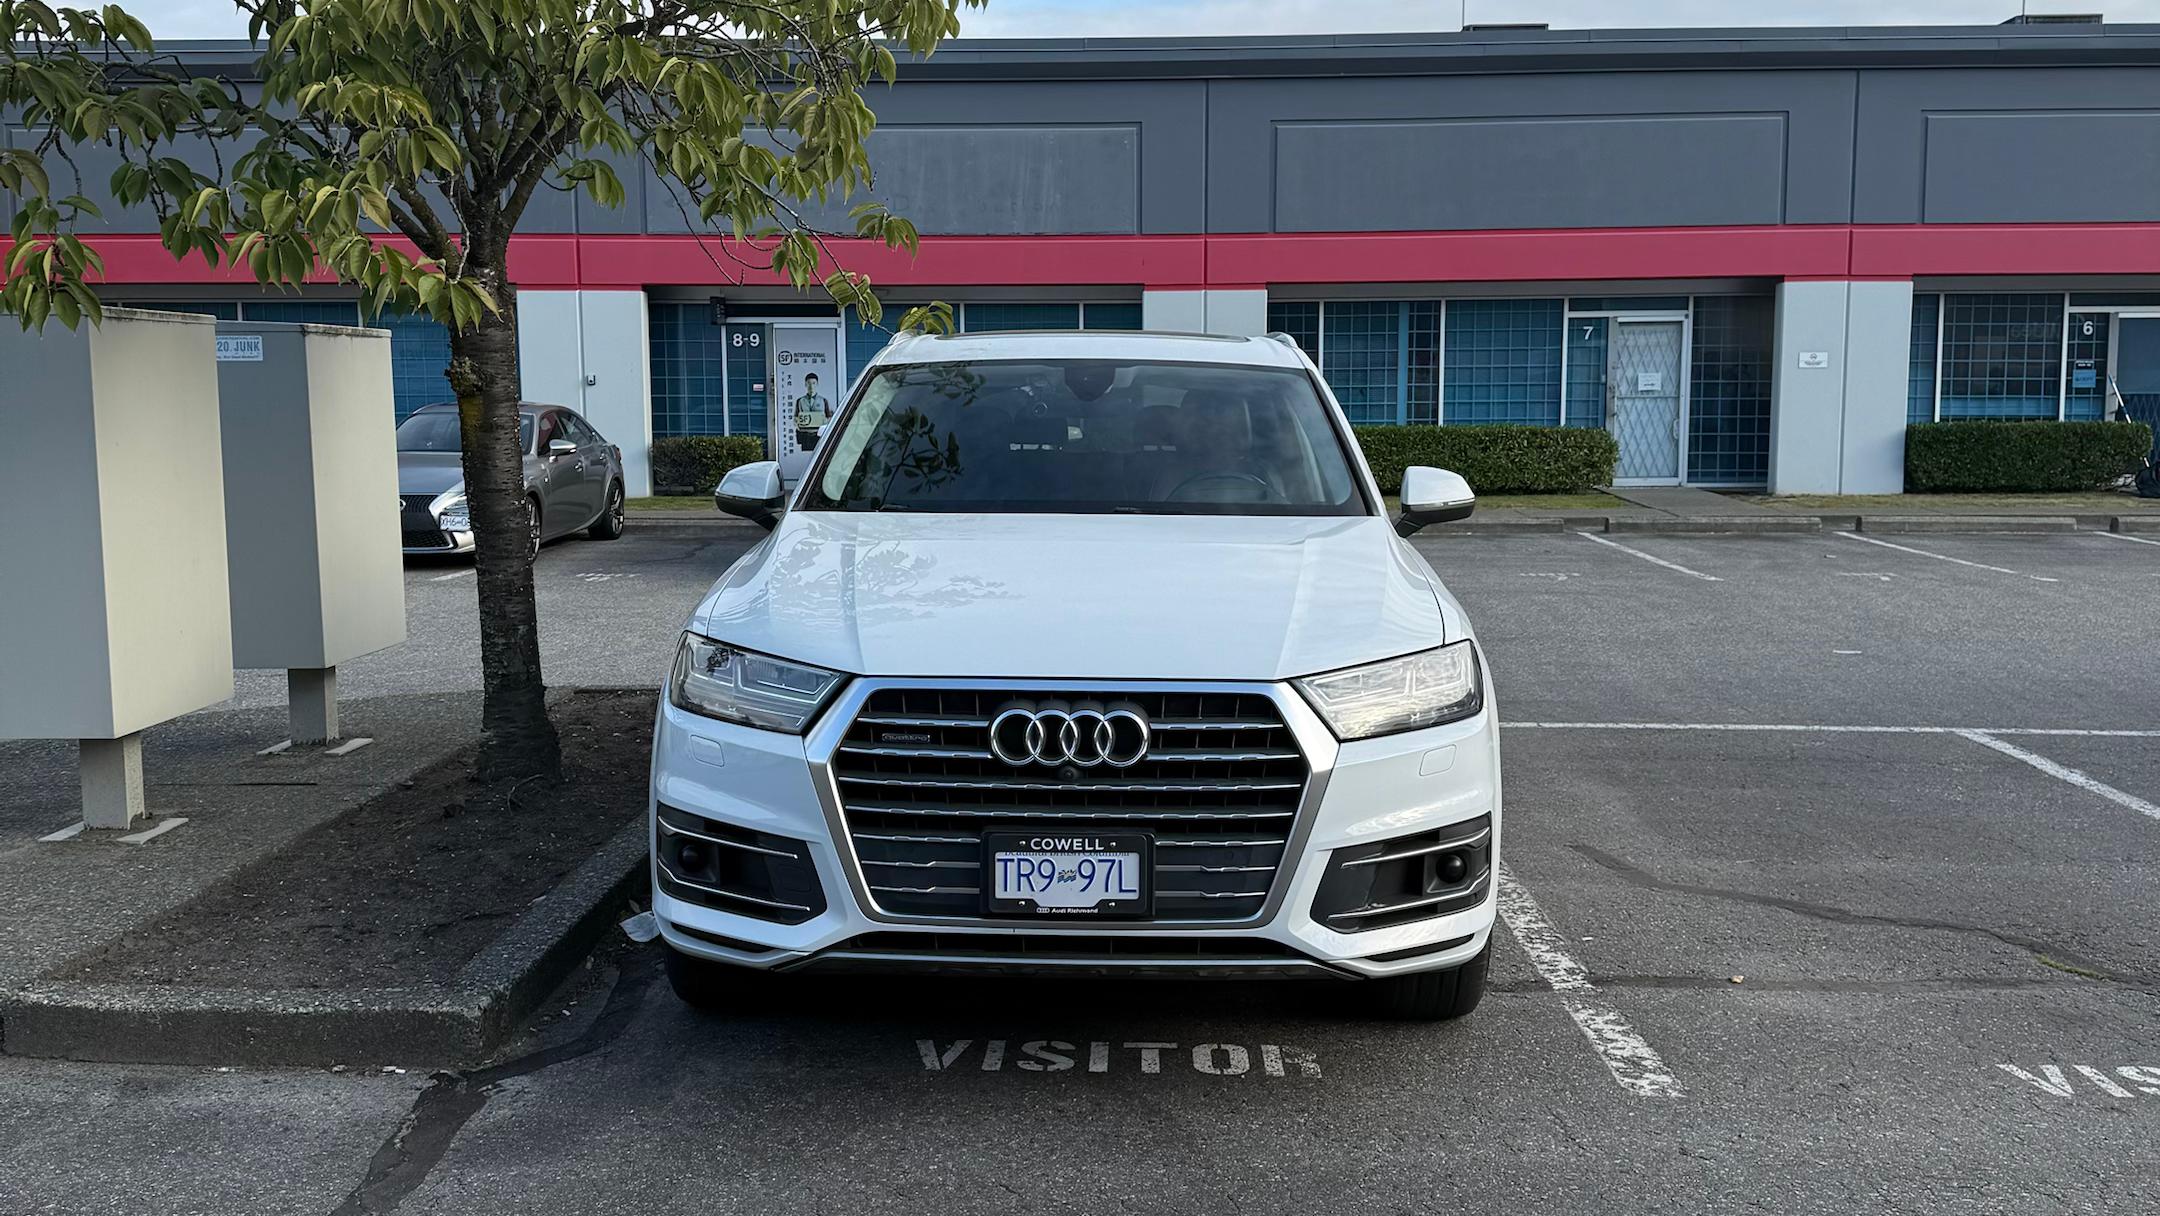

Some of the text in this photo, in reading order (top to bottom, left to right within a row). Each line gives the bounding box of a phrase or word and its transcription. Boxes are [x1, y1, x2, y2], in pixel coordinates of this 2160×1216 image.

[1583, 326, 1594, 340] 7
[2083, 321, 2093, 335] 6
[733, 333, 760, 346] 8-9
[1030, 838, 1105, 850] COWELL
[915, 1040, 1323, 1078] VISITOR
